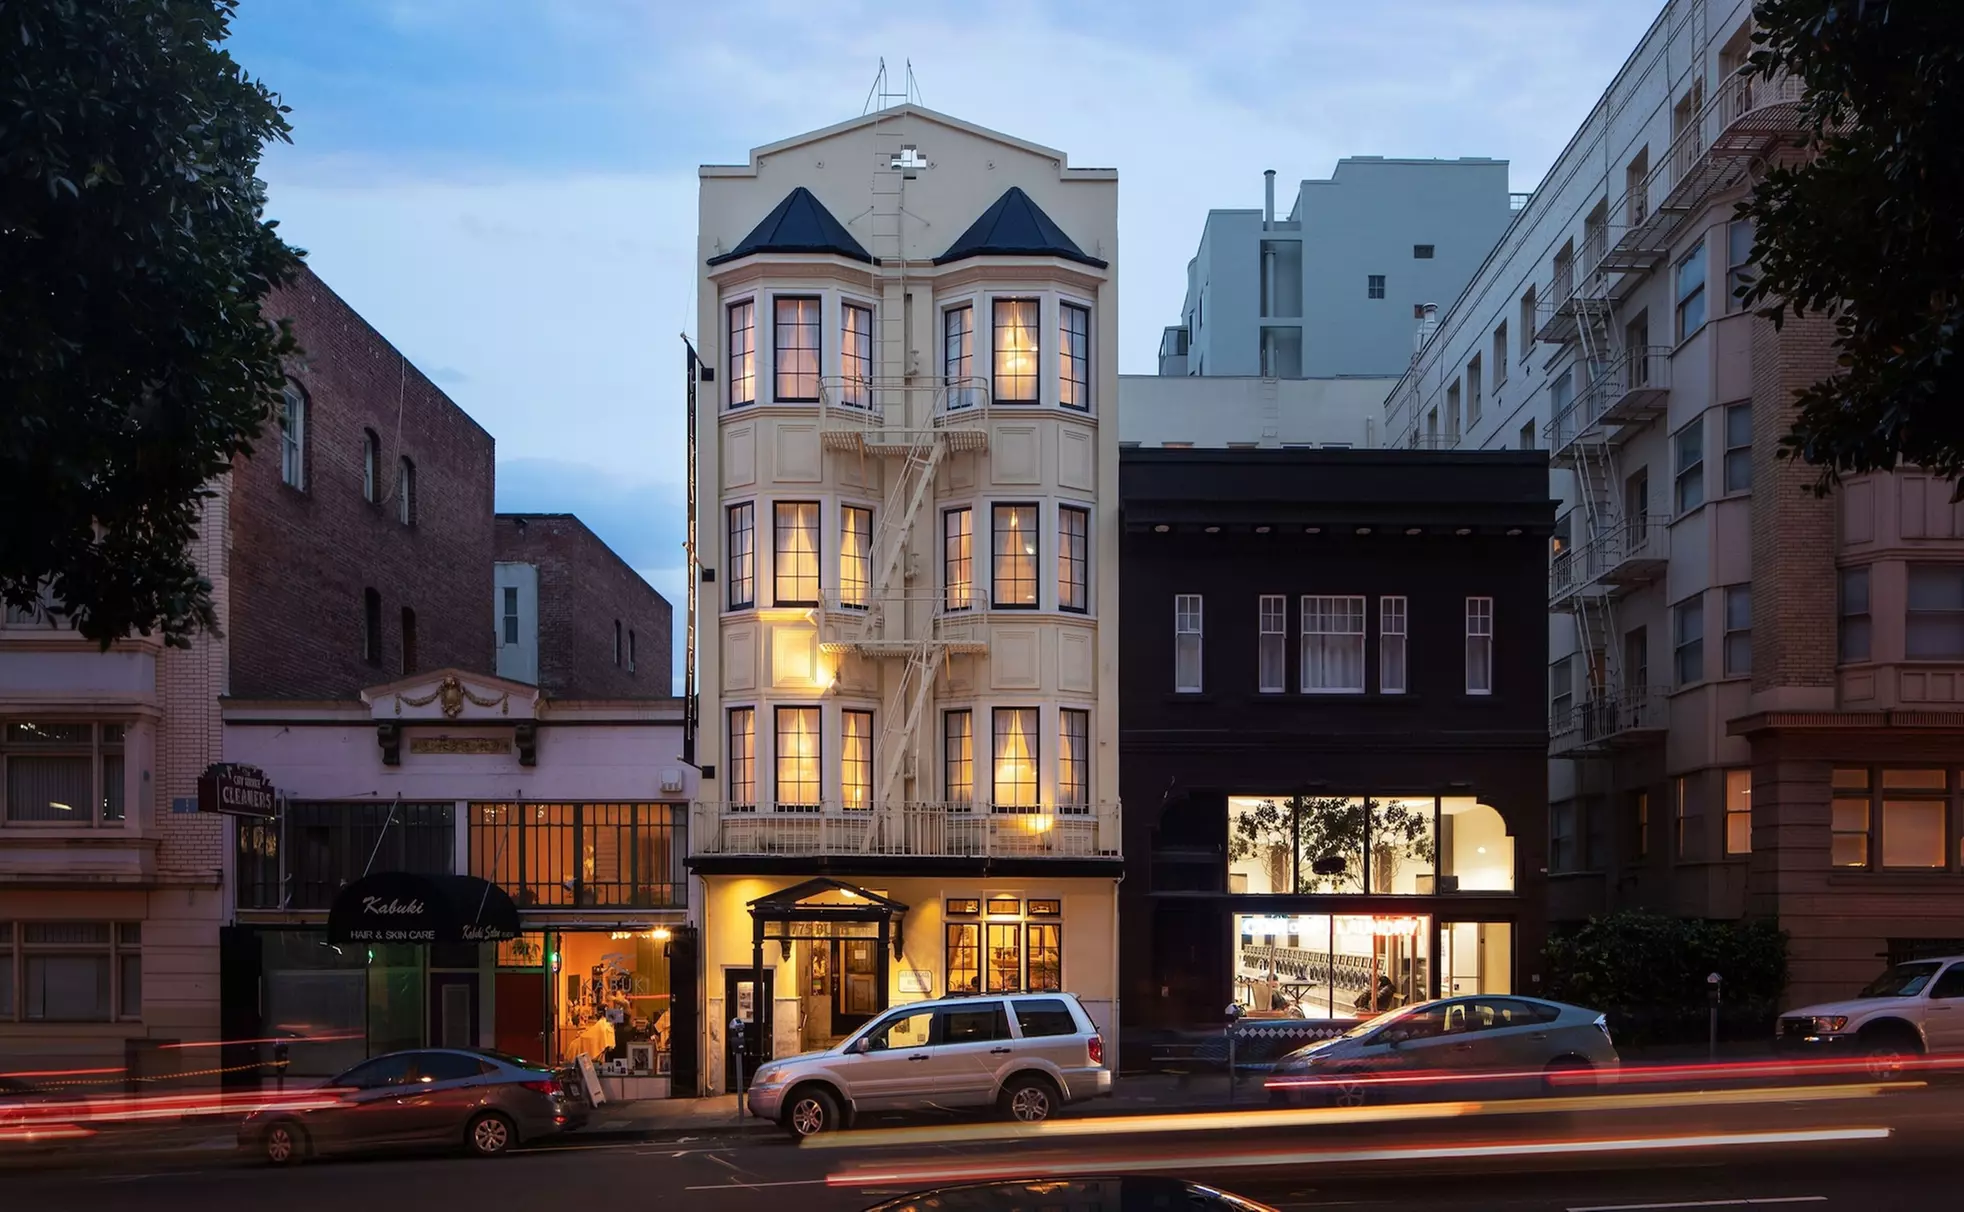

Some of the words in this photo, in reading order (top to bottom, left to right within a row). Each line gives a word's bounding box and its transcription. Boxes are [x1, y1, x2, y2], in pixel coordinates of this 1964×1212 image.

[222, 786, 272, 809] CLEANERS
[362, 895, 425, 915] Kabuki
[350, 930, 373, 940] HAIR
[375, 930, 383, 940] &
[385, 930, 407, 940] SKIN
[408, 930, 436, 940] CARE
[791, 923, 813, 935] 775
[582, 977, 651, 993] KABUKI
